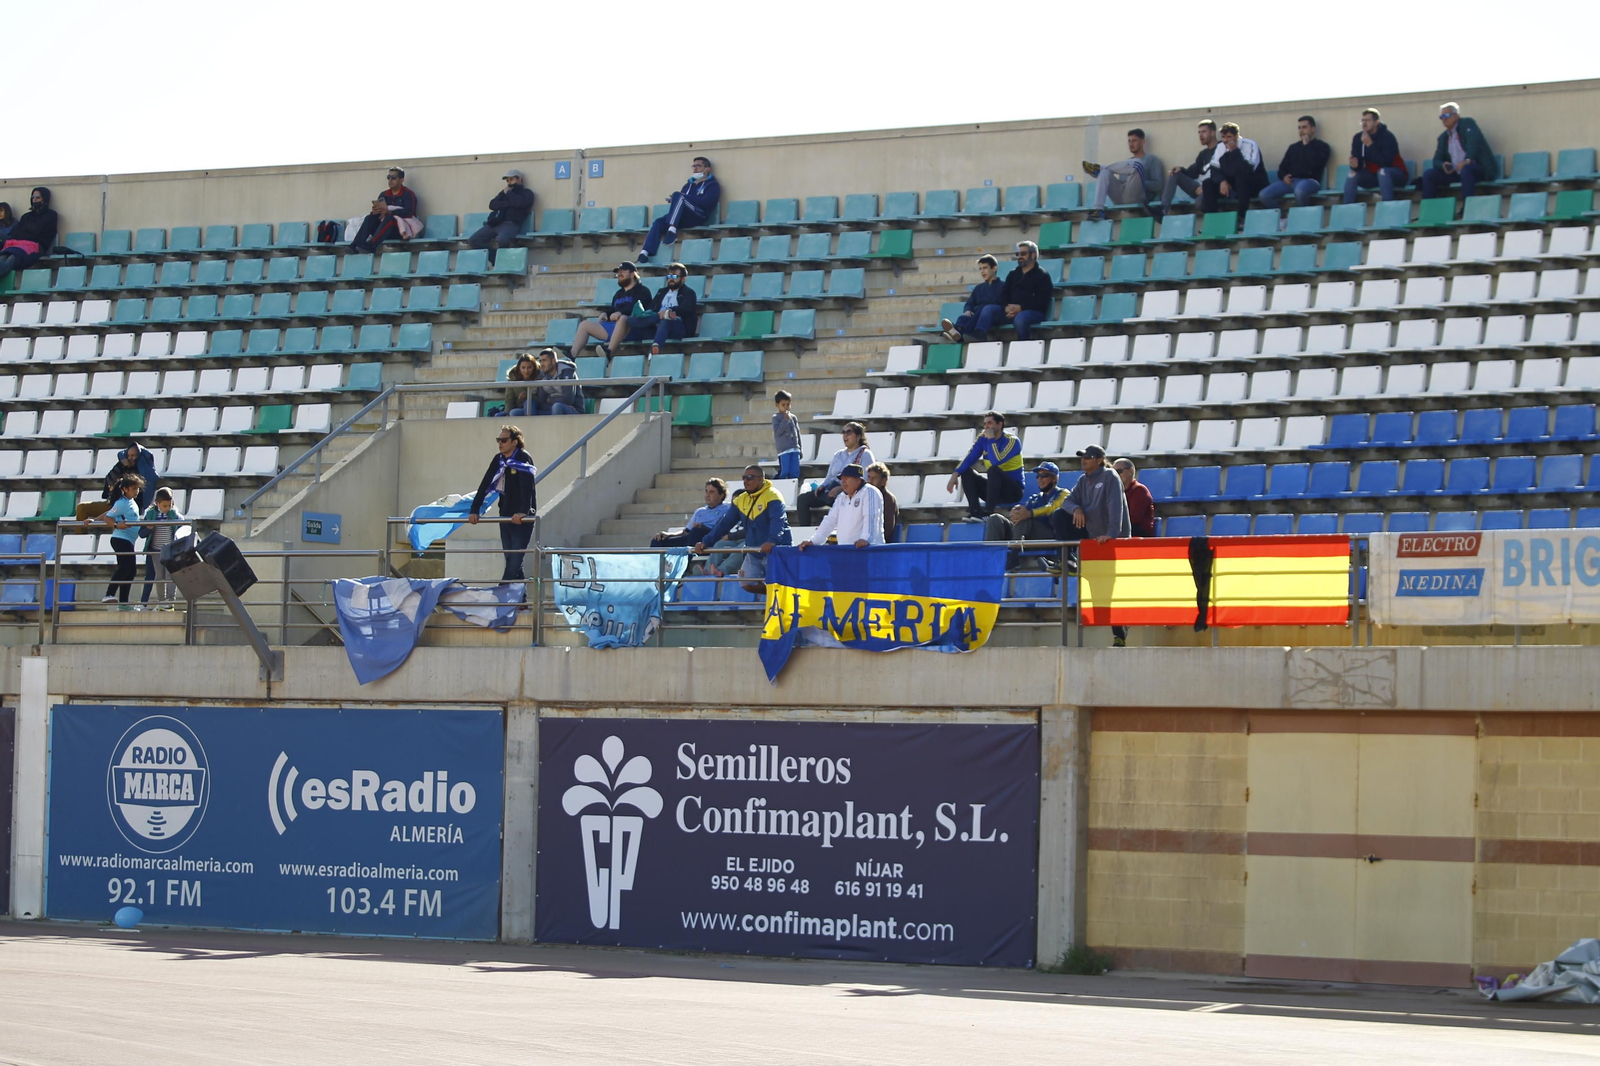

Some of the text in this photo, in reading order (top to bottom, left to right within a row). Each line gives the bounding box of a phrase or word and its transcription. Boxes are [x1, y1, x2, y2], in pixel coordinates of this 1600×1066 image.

[558, 164, 566, 174] A
[592, 163, 599, 173] B
[307, 520, 322, 529] Salida
[1401, 536, 1477, 552] ELECTRO
[1502, 535, 1600, 587] BRIG
[1401, 575, 1478, 590] MEDINA
[132, 746, 187, 765] RADIO
[676, 742, 851, 785] Semilleros
[123, 771, 195, 801] MARCA
[302, 770, 477, 814] esRadio
[675, 795, 1009, 849] Confimaplant, S.L.
[390, 824, 464, 844] ALMERÍA
[60, 853, 254, 874] www.radiomarcaalmeria.com
[279, 860, 459, 881] www.esradioalmeria.com
[726, 856, 795, 874] EL EJIDO
[855, 858, 904, 878] NÍJAR
[107, 877, 202, 907] 92.1 FM
[711, 875, 810, 894] 950 48 96 48
[834, 880, 923, 899] 616 91 19 41
[326, 887, 442, 917] 103.4 FM
[681, 910, 954, 942] www.confimaplant.com
